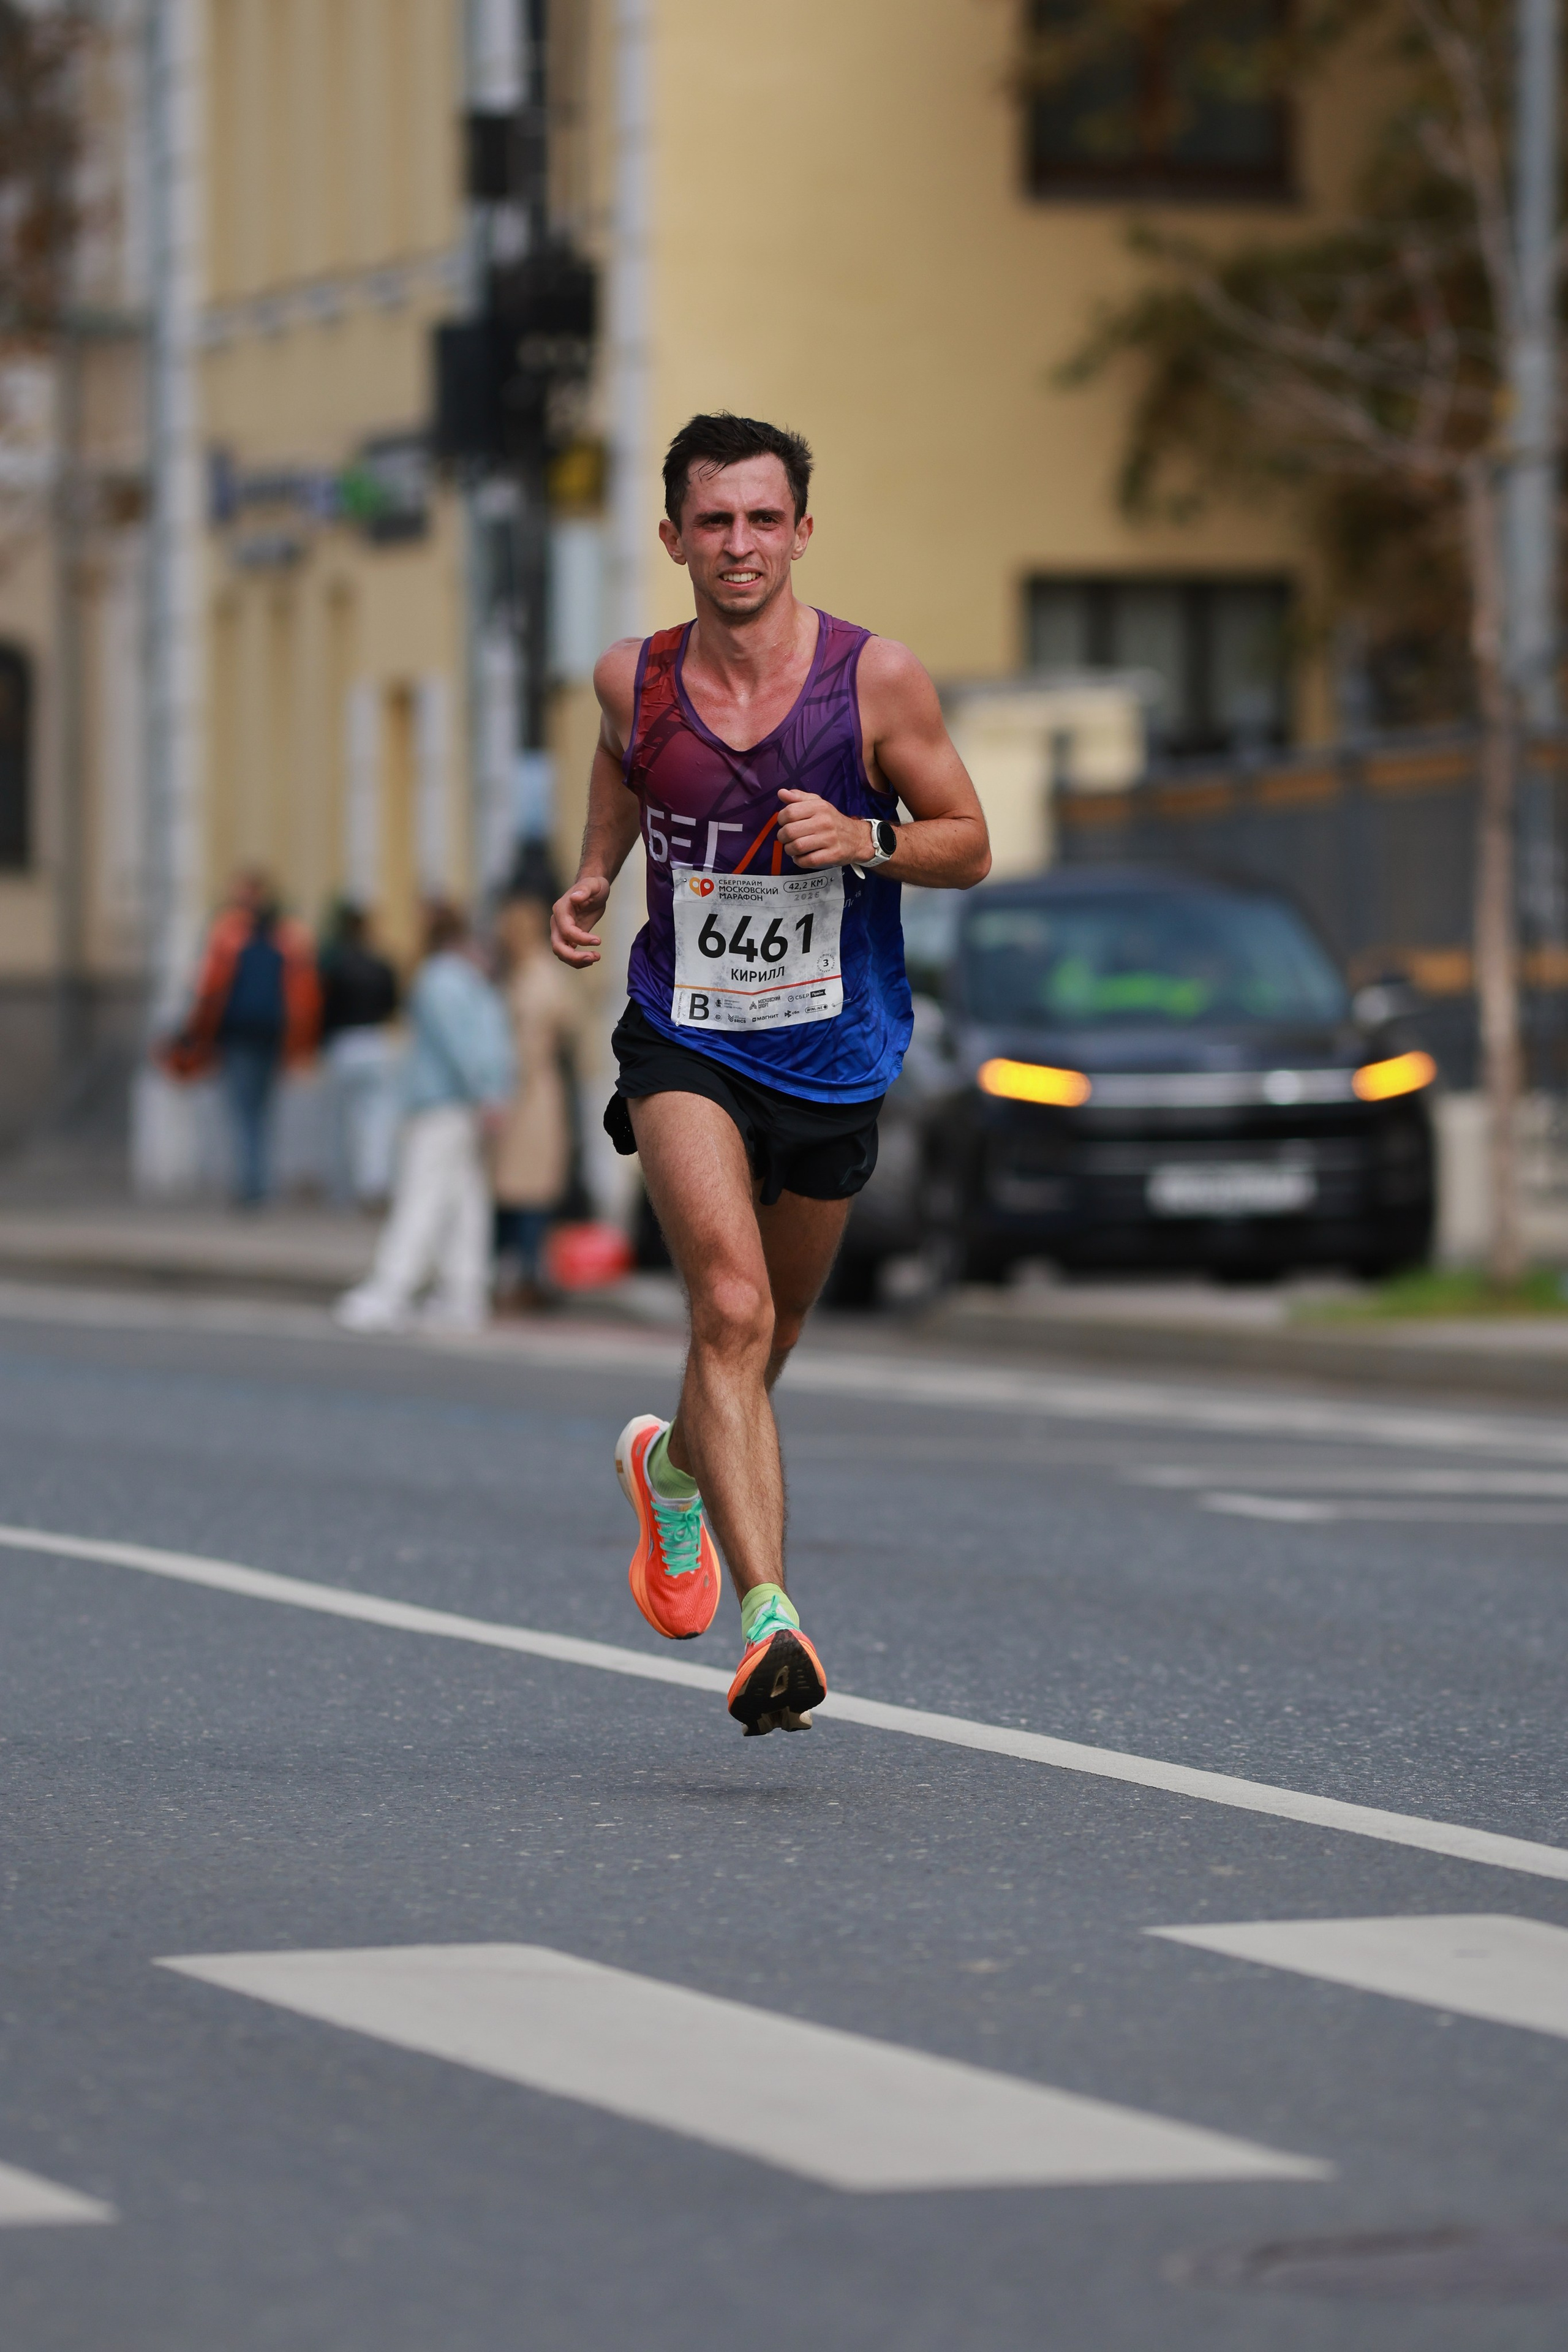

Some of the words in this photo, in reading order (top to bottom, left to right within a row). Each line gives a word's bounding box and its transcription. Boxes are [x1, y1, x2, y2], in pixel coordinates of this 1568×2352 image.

[810, 879, 823, 888] КМ
[719, 886, 778, 895] МОСКОВСКИЙ
[794, 892, 820, 900] 2026
[698, 913, 814, 963] 6461
[731, 966, 785, 982] КИРИЛЛ
[689, 993, 709, 1020] B
